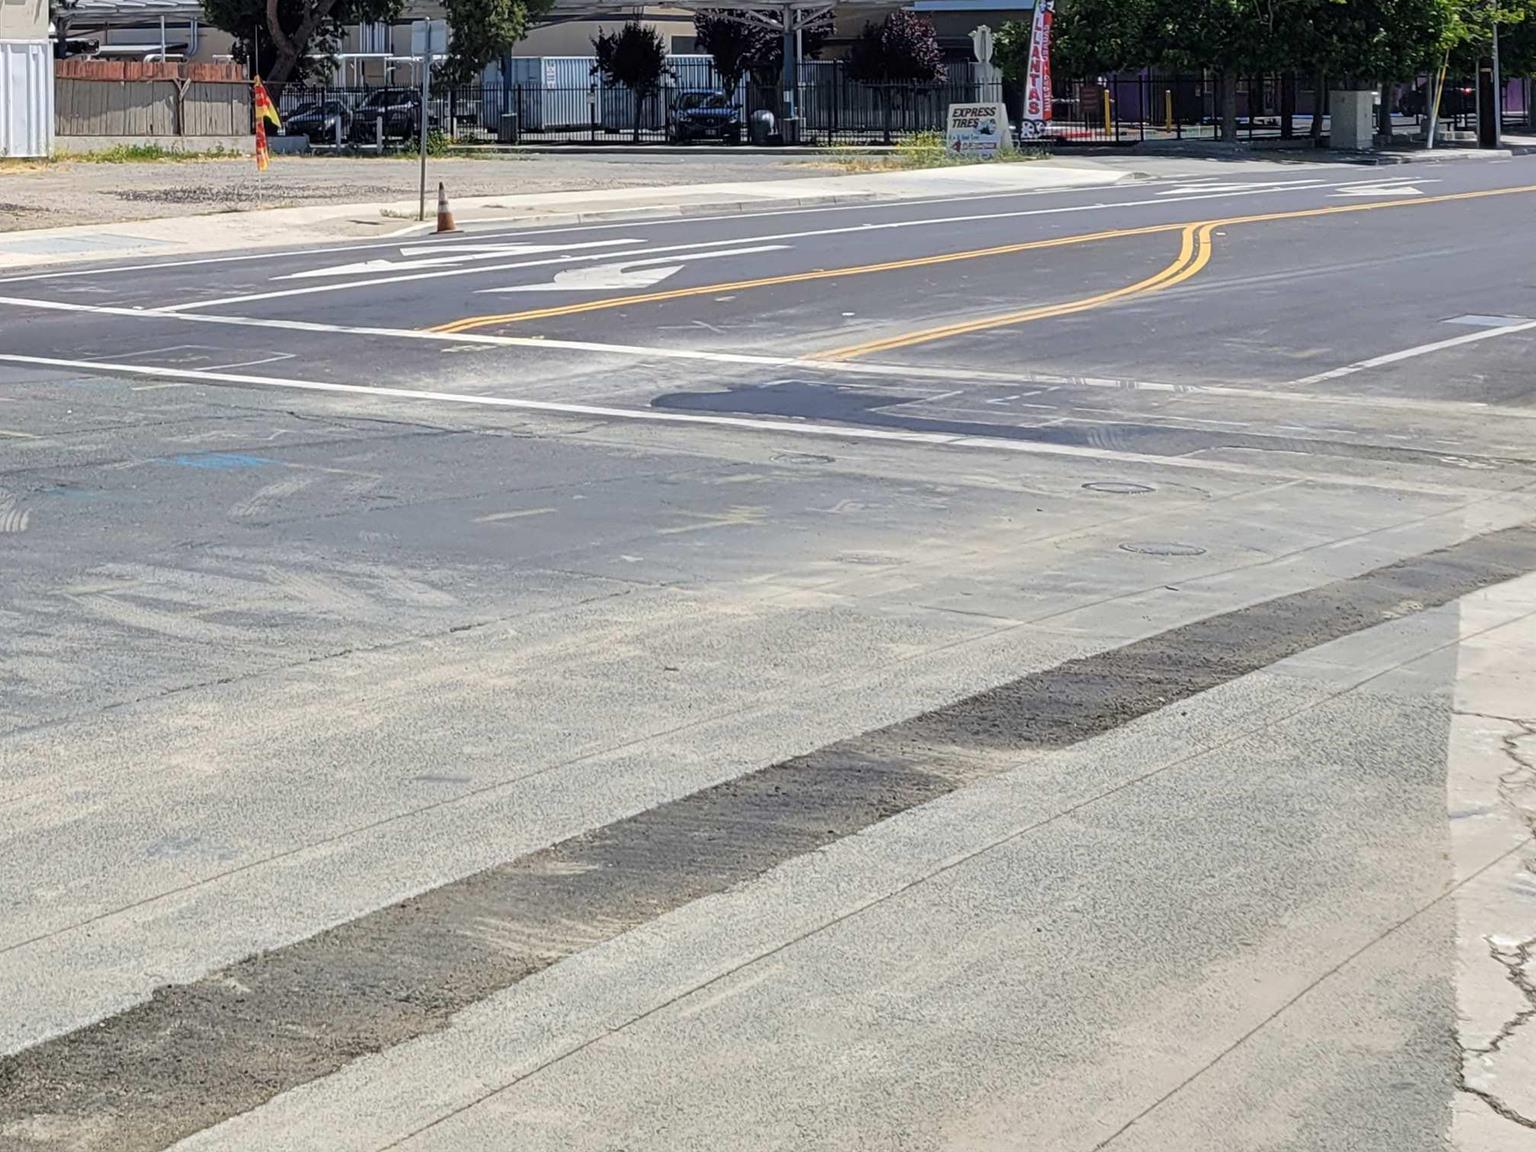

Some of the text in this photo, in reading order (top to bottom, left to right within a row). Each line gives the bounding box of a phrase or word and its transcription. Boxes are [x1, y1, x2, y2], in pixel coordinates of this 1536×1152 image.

[1027, 16, 1043, 116] LLANTAS
[952, 107, 997, 118] EXPRESS
[952, 118, 980, 128] TIRES
